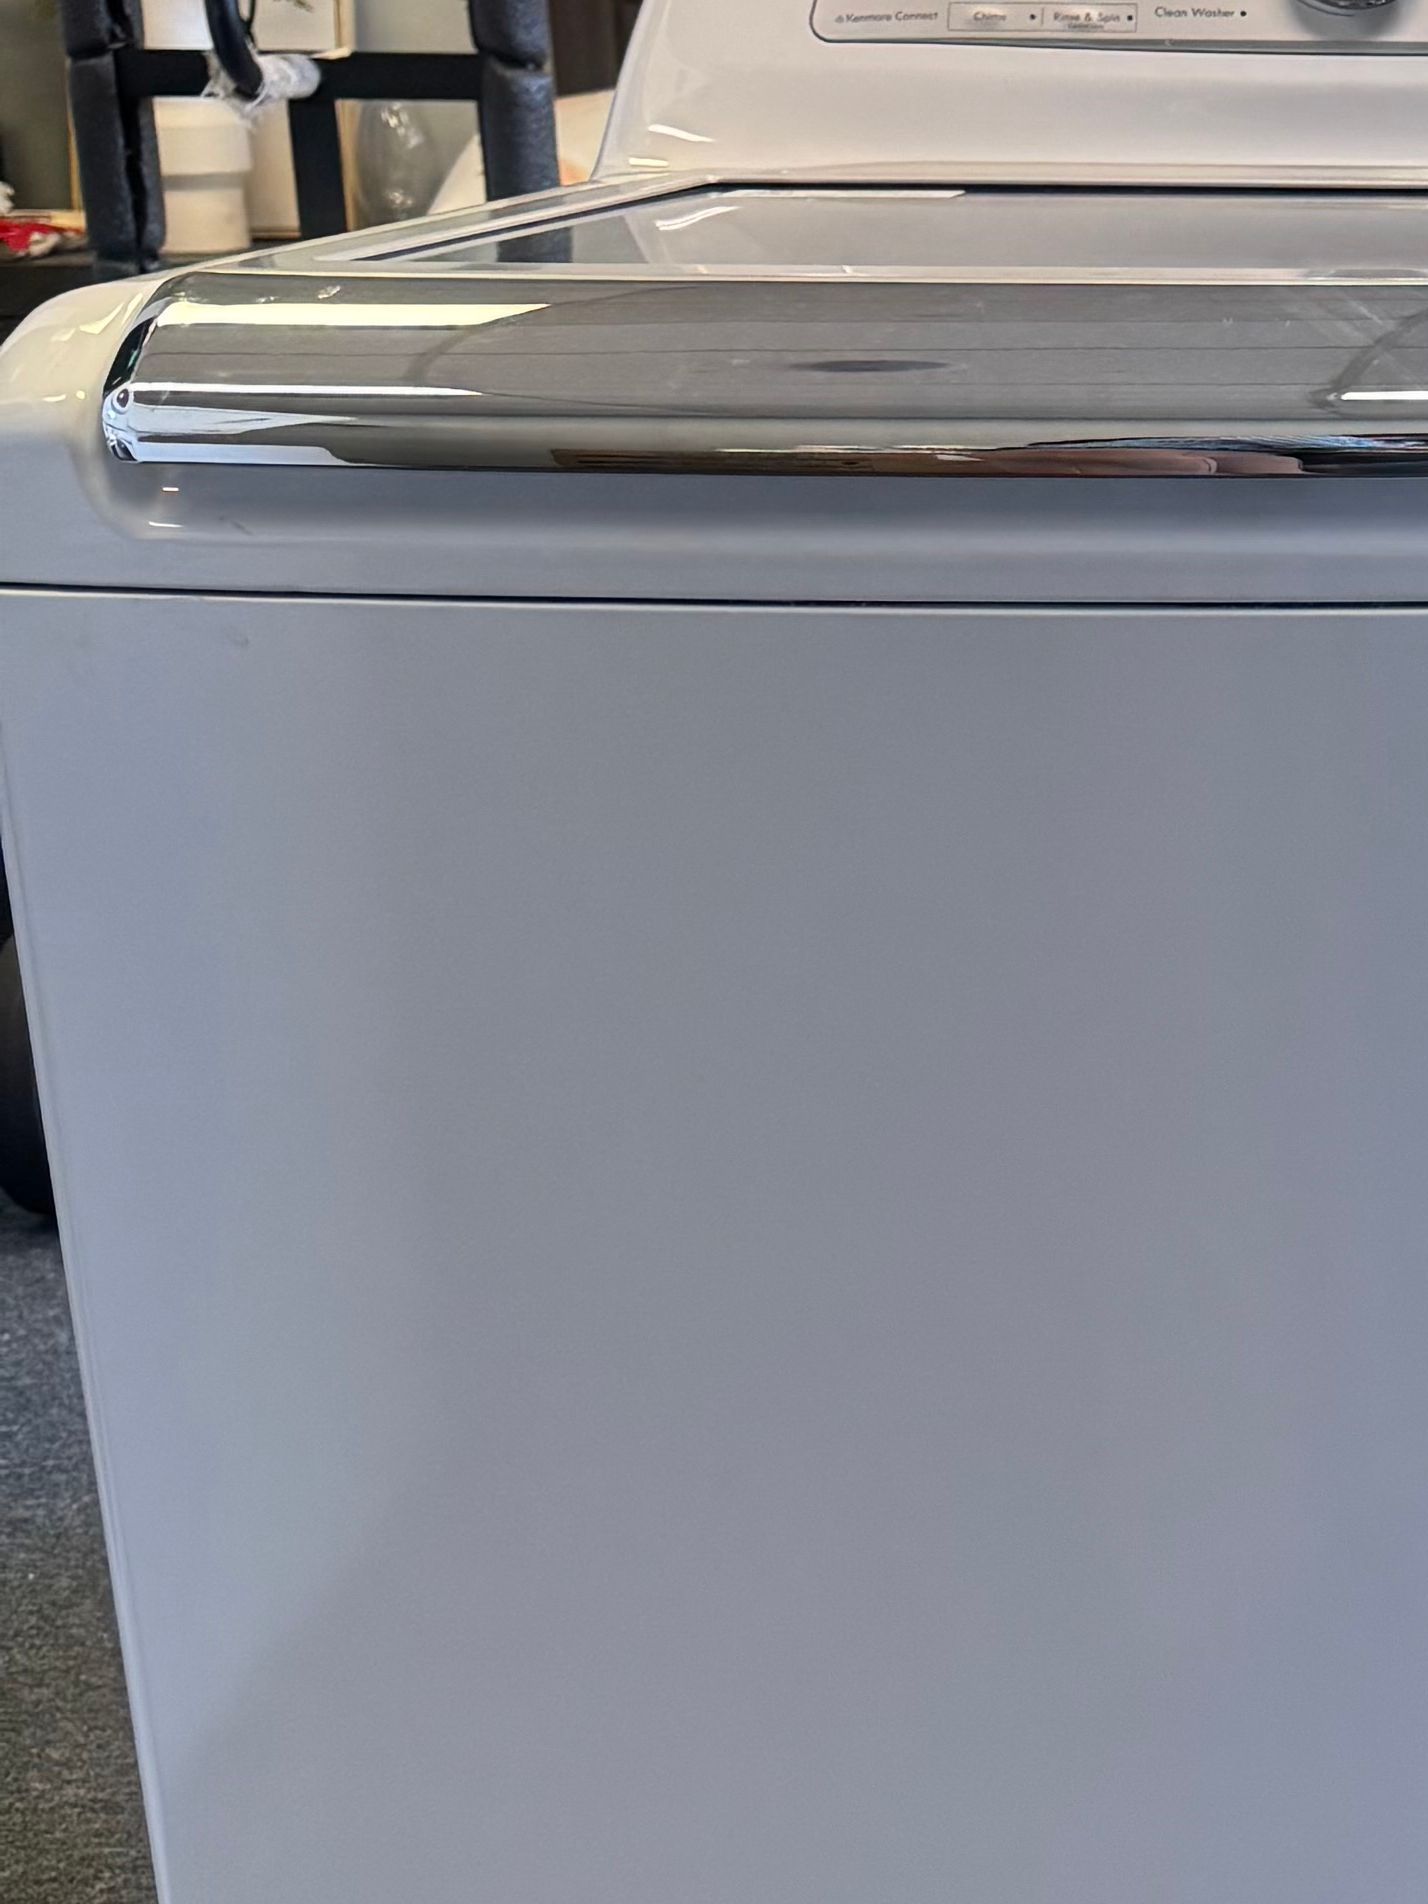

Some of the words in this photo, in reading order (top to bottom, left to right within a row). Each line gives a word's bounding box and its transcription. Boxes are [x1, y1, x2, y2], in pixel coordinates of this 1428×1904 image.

[895, 11, 938, 21] Connect
[1154, 6, 1188, 17] Clean
[1191, 8, 1235, 17] Washer
